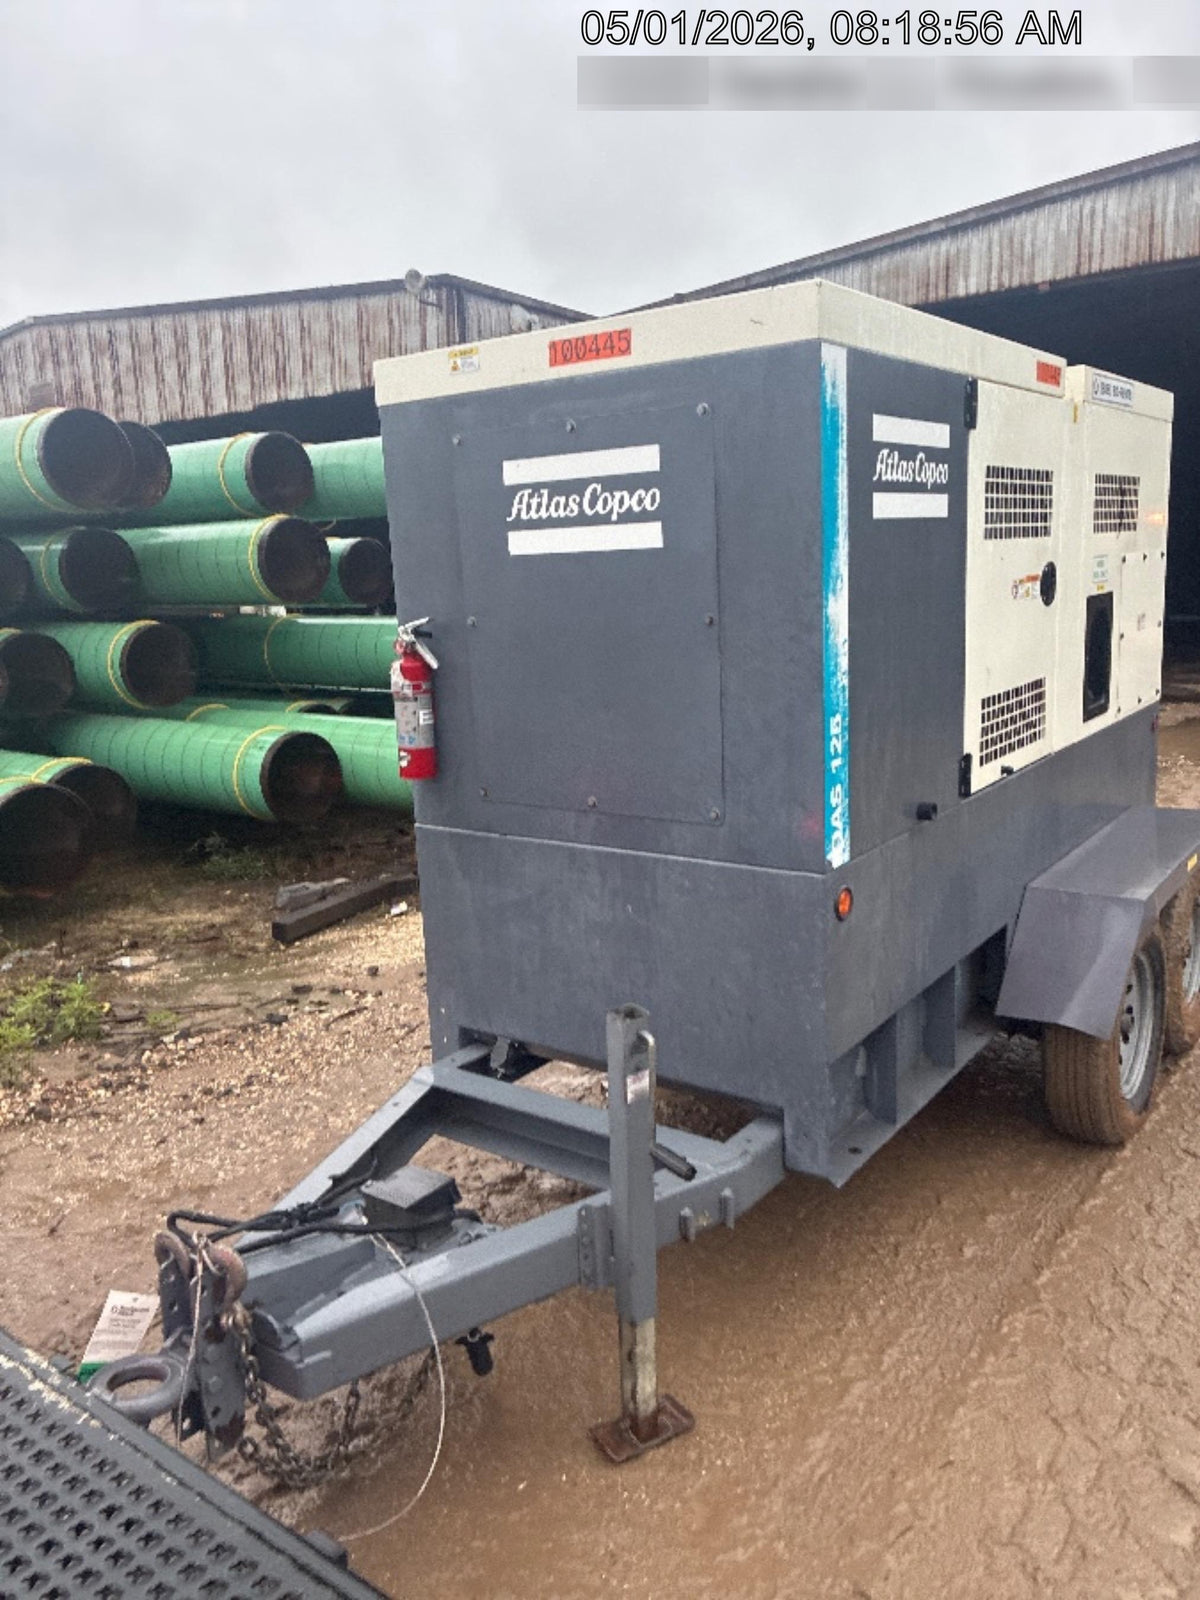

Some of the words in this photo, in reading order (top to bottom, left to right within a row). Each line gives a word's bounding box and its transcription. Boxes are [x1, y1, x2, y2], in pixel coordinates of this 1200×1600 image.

[550, 330, 631, 364] 100445
[873, 448, 914, 484] Atlas
[915, 451, 949, 490] Copco
[507, 488, 579, 522] Atlas
[582, 483, 661, 521] Copco
